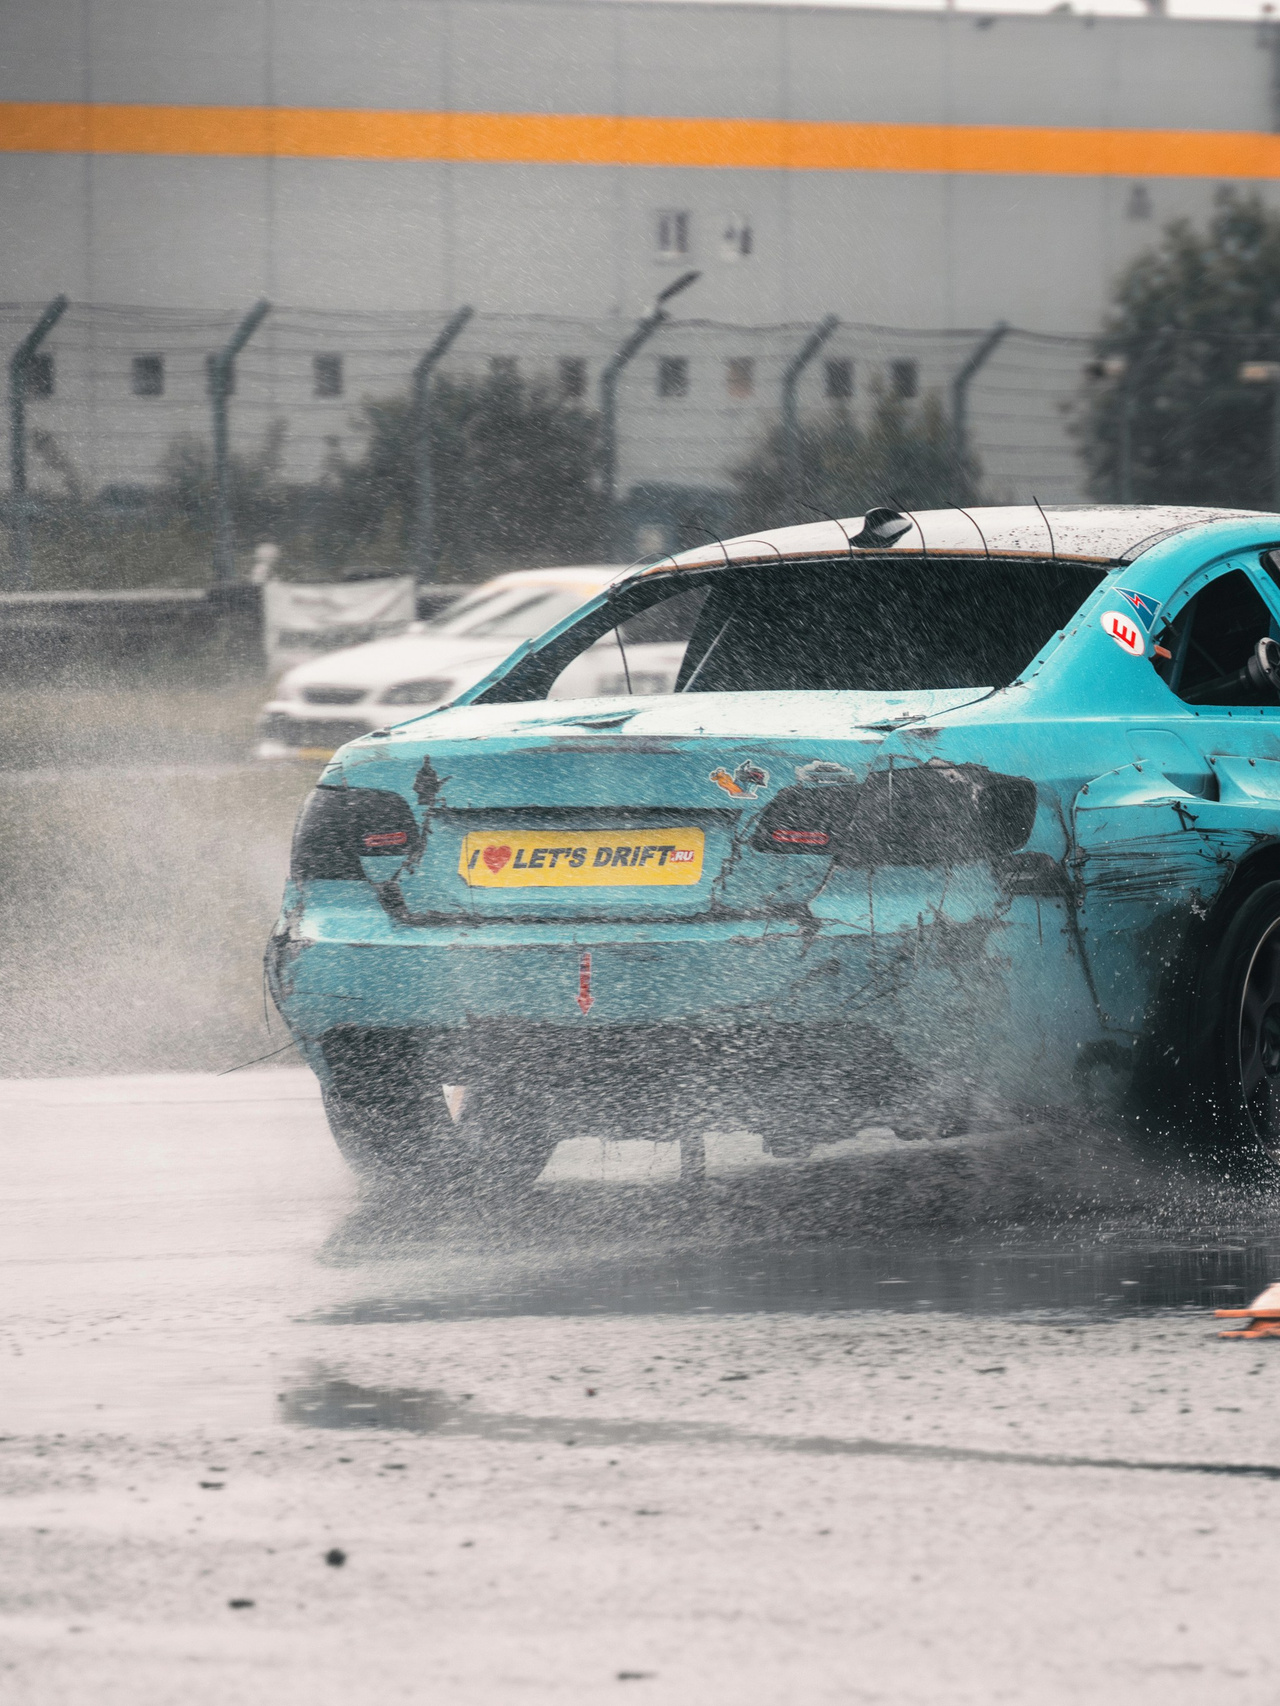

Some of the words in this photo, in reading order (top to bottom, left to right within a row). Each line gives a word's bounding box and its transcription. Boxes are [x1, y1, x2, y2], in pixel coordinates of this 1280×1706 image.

[1112, 618, 1137, 649] E
[468, 849, 480, 869] I
[512, 847, 588, 869] LET'S
[592, 845, 676, 868] DRIFT
